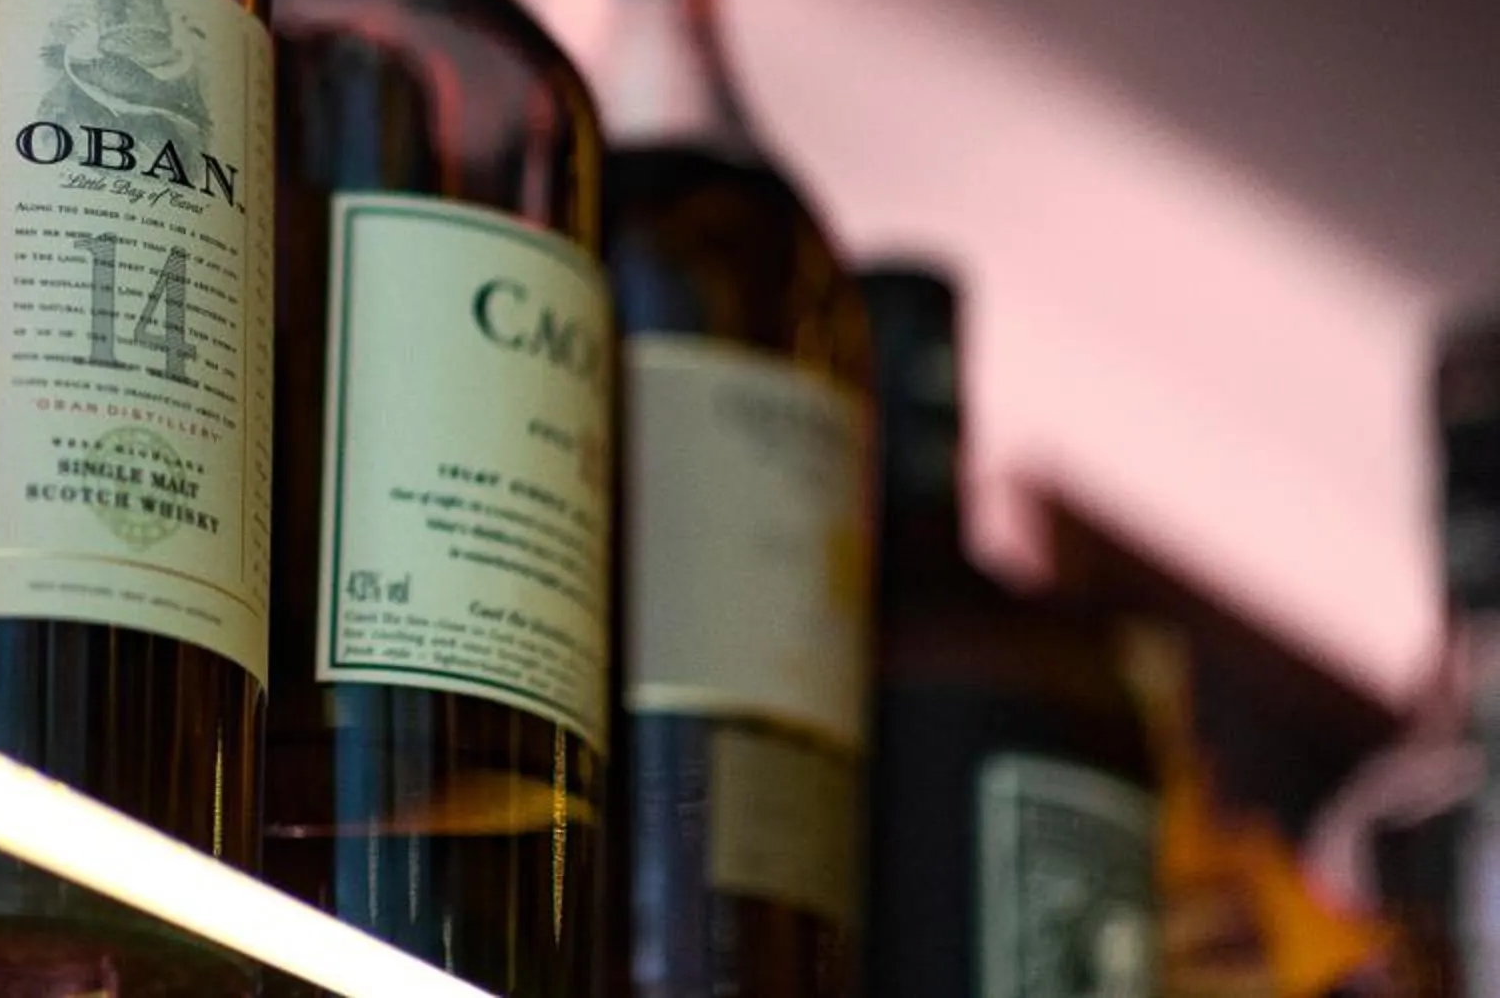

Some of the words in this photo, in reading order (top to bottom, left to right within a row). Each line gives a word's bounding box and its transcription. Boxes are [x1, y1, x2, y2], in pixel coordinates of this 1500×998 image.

[16, 121, 238, 208] OBAN
[148, 186, 171, 208] of
[72, 232, 200, 386] 14
[107, 404, 223, 443] DISTILLERY
[57, 457, 143, 485] SINGLE
[152, 470, 199, 500] MALT
[25, 482, 130, 509] SCOTCH
[140, 496, 220, 534] WHISKY
